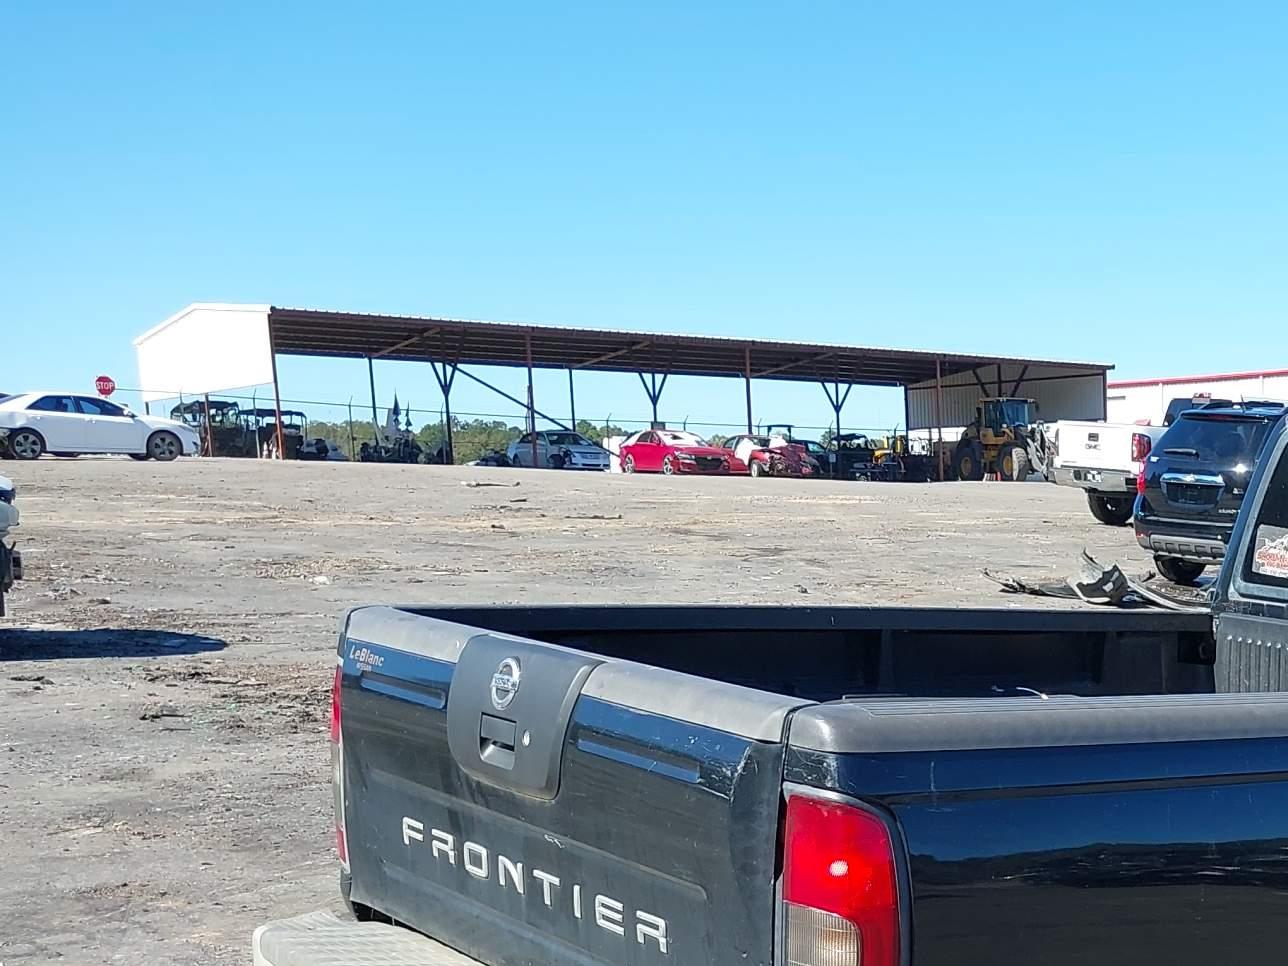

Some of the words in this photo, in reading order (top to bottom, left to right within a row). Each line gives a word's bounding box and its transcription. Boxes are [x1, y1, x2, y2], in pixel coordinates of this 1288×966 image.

[96, 381, 115, 390] STOP
[349, 645, 384, 667] LeBlanc
[402, 816, 669, 954] FRONTIER
